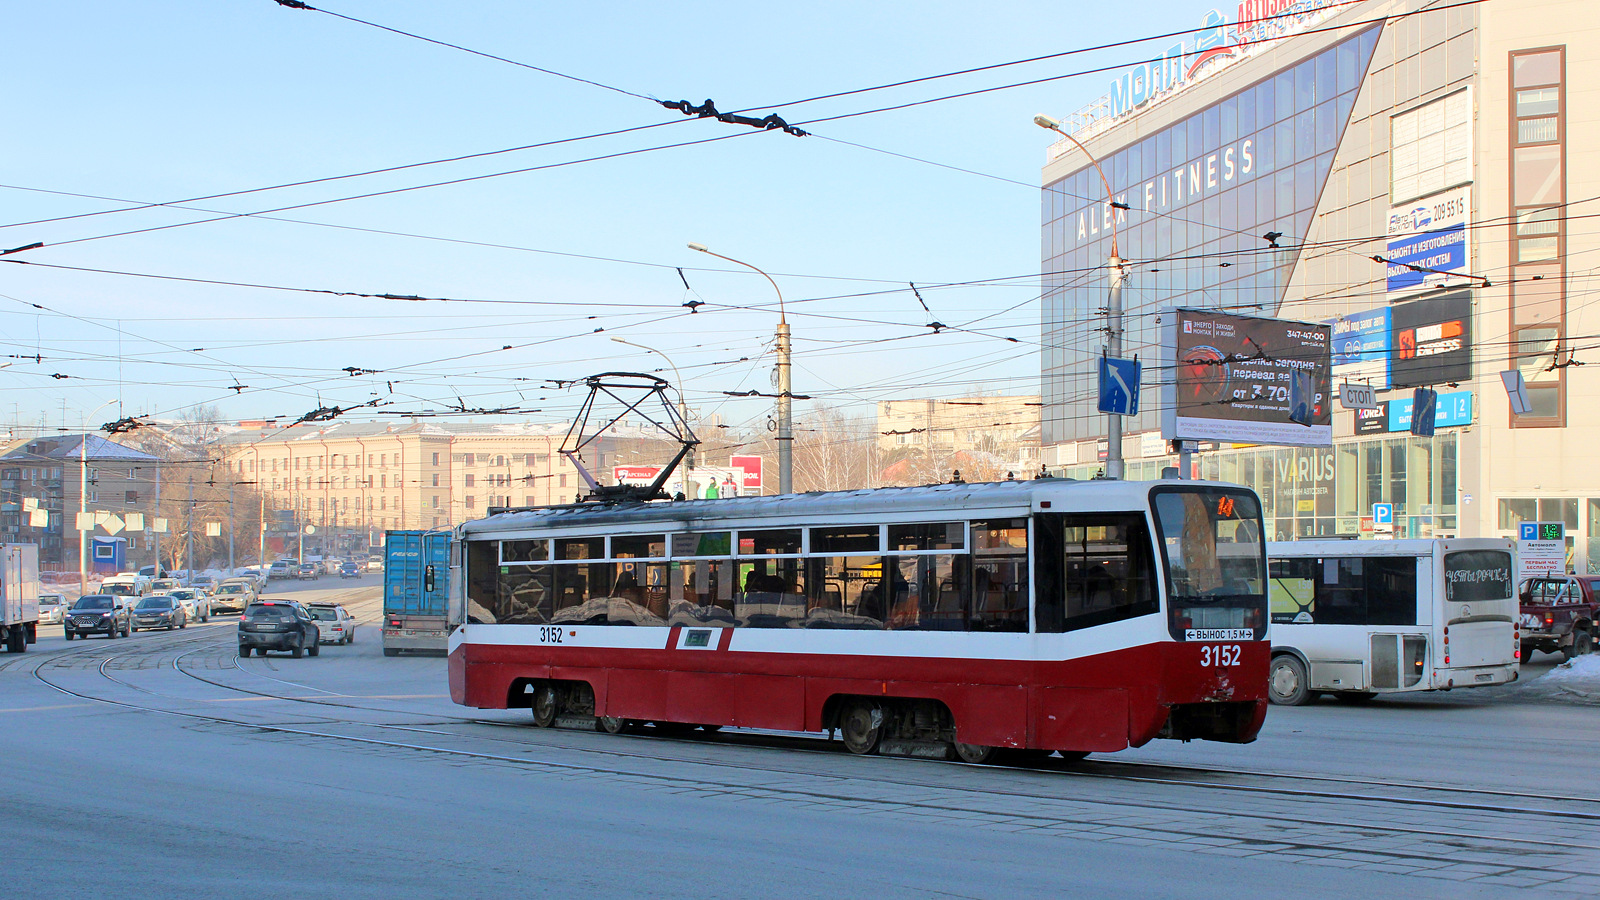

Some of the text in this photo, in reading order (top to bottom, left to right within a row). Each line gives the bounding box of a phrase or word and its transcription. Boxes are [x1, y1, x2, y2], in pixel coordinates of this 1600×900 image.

[1110, 41, 1184, 118] МОЛЛ
[1077, 139, 1253, 241] ALEX FITNESS
[1433, 203, 1445, 222] 209
[1447, 200, 1455, 218] 55
[1456, 197, 1464, 214] 15
[1387, 230, 1465, 260] РЕМОНТ И ИЗГОТОВЛЕНИЕ
[1426, 252, 1451, 267] СИСТЕМ
[1193, 321, 1212, 329] ЭНЕРГО
[1193, 328, 1212, 336] МОНТАЖ
[1287, 330, 1325, 341] 347-47-00
[1274, 358, 1315, 370] сегодня
[1233, 369, 1275, 382] переезд
[1232, 389, 1247, 399] от
[1346, 390, 1371, 404] СТОП
[1459, 398, 1465, 412] 2
[1278, 455, 1334, 483] VARIUS
[1283, 488, 1303, 497] МАГАЗИН
[540, 626, 563, 643] 3152
[1196, 629, 1245, 640] ВЫНОС 1,5 М
[1200, 645, 1241, 666] 3152
